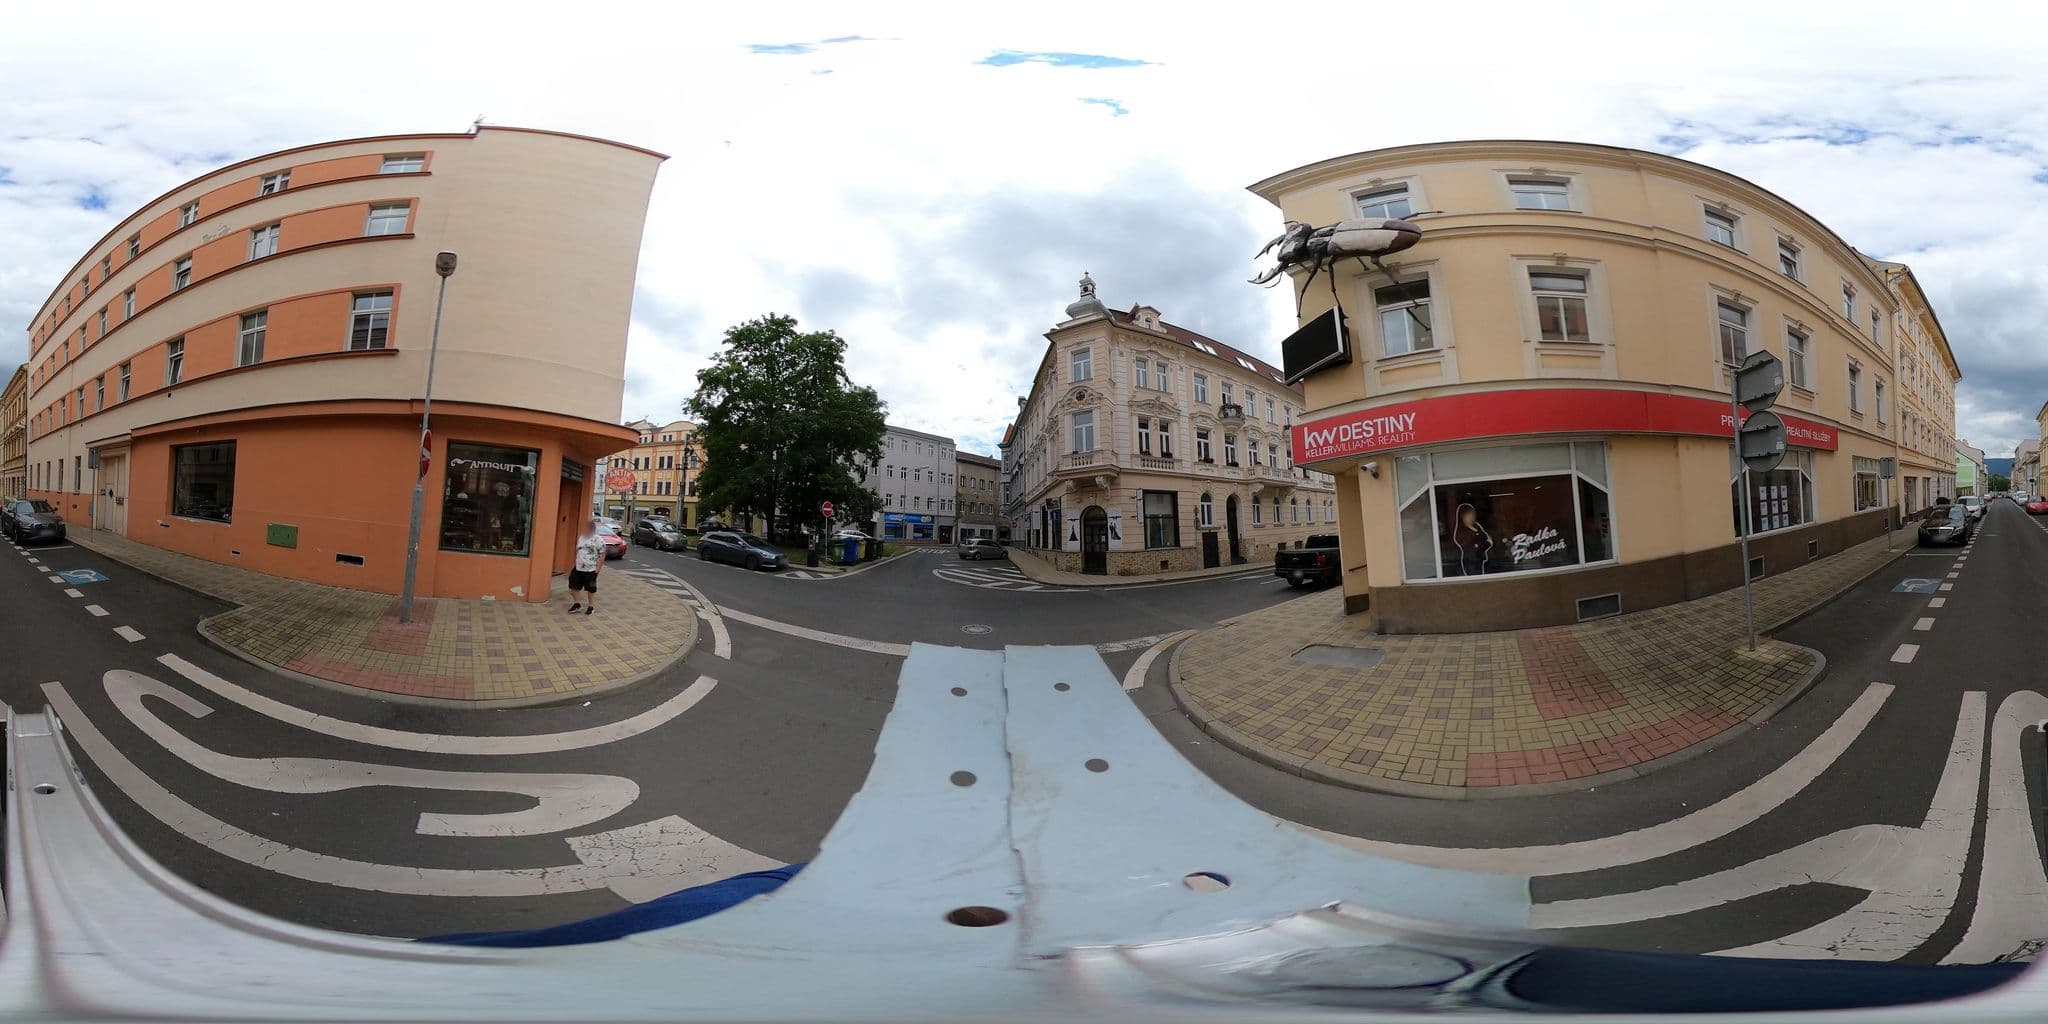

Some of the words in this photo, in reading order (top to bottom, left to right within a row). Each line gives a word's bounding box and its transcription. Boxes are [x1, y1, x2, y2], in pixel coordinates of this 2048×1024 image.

[1339, 412, 1416, 442] DESTINY
[1378, 431, 1416, 446] REALITY
[1512, 526, 1559, 548] Radka
[1511, 538, 1567, 565] Paulová
